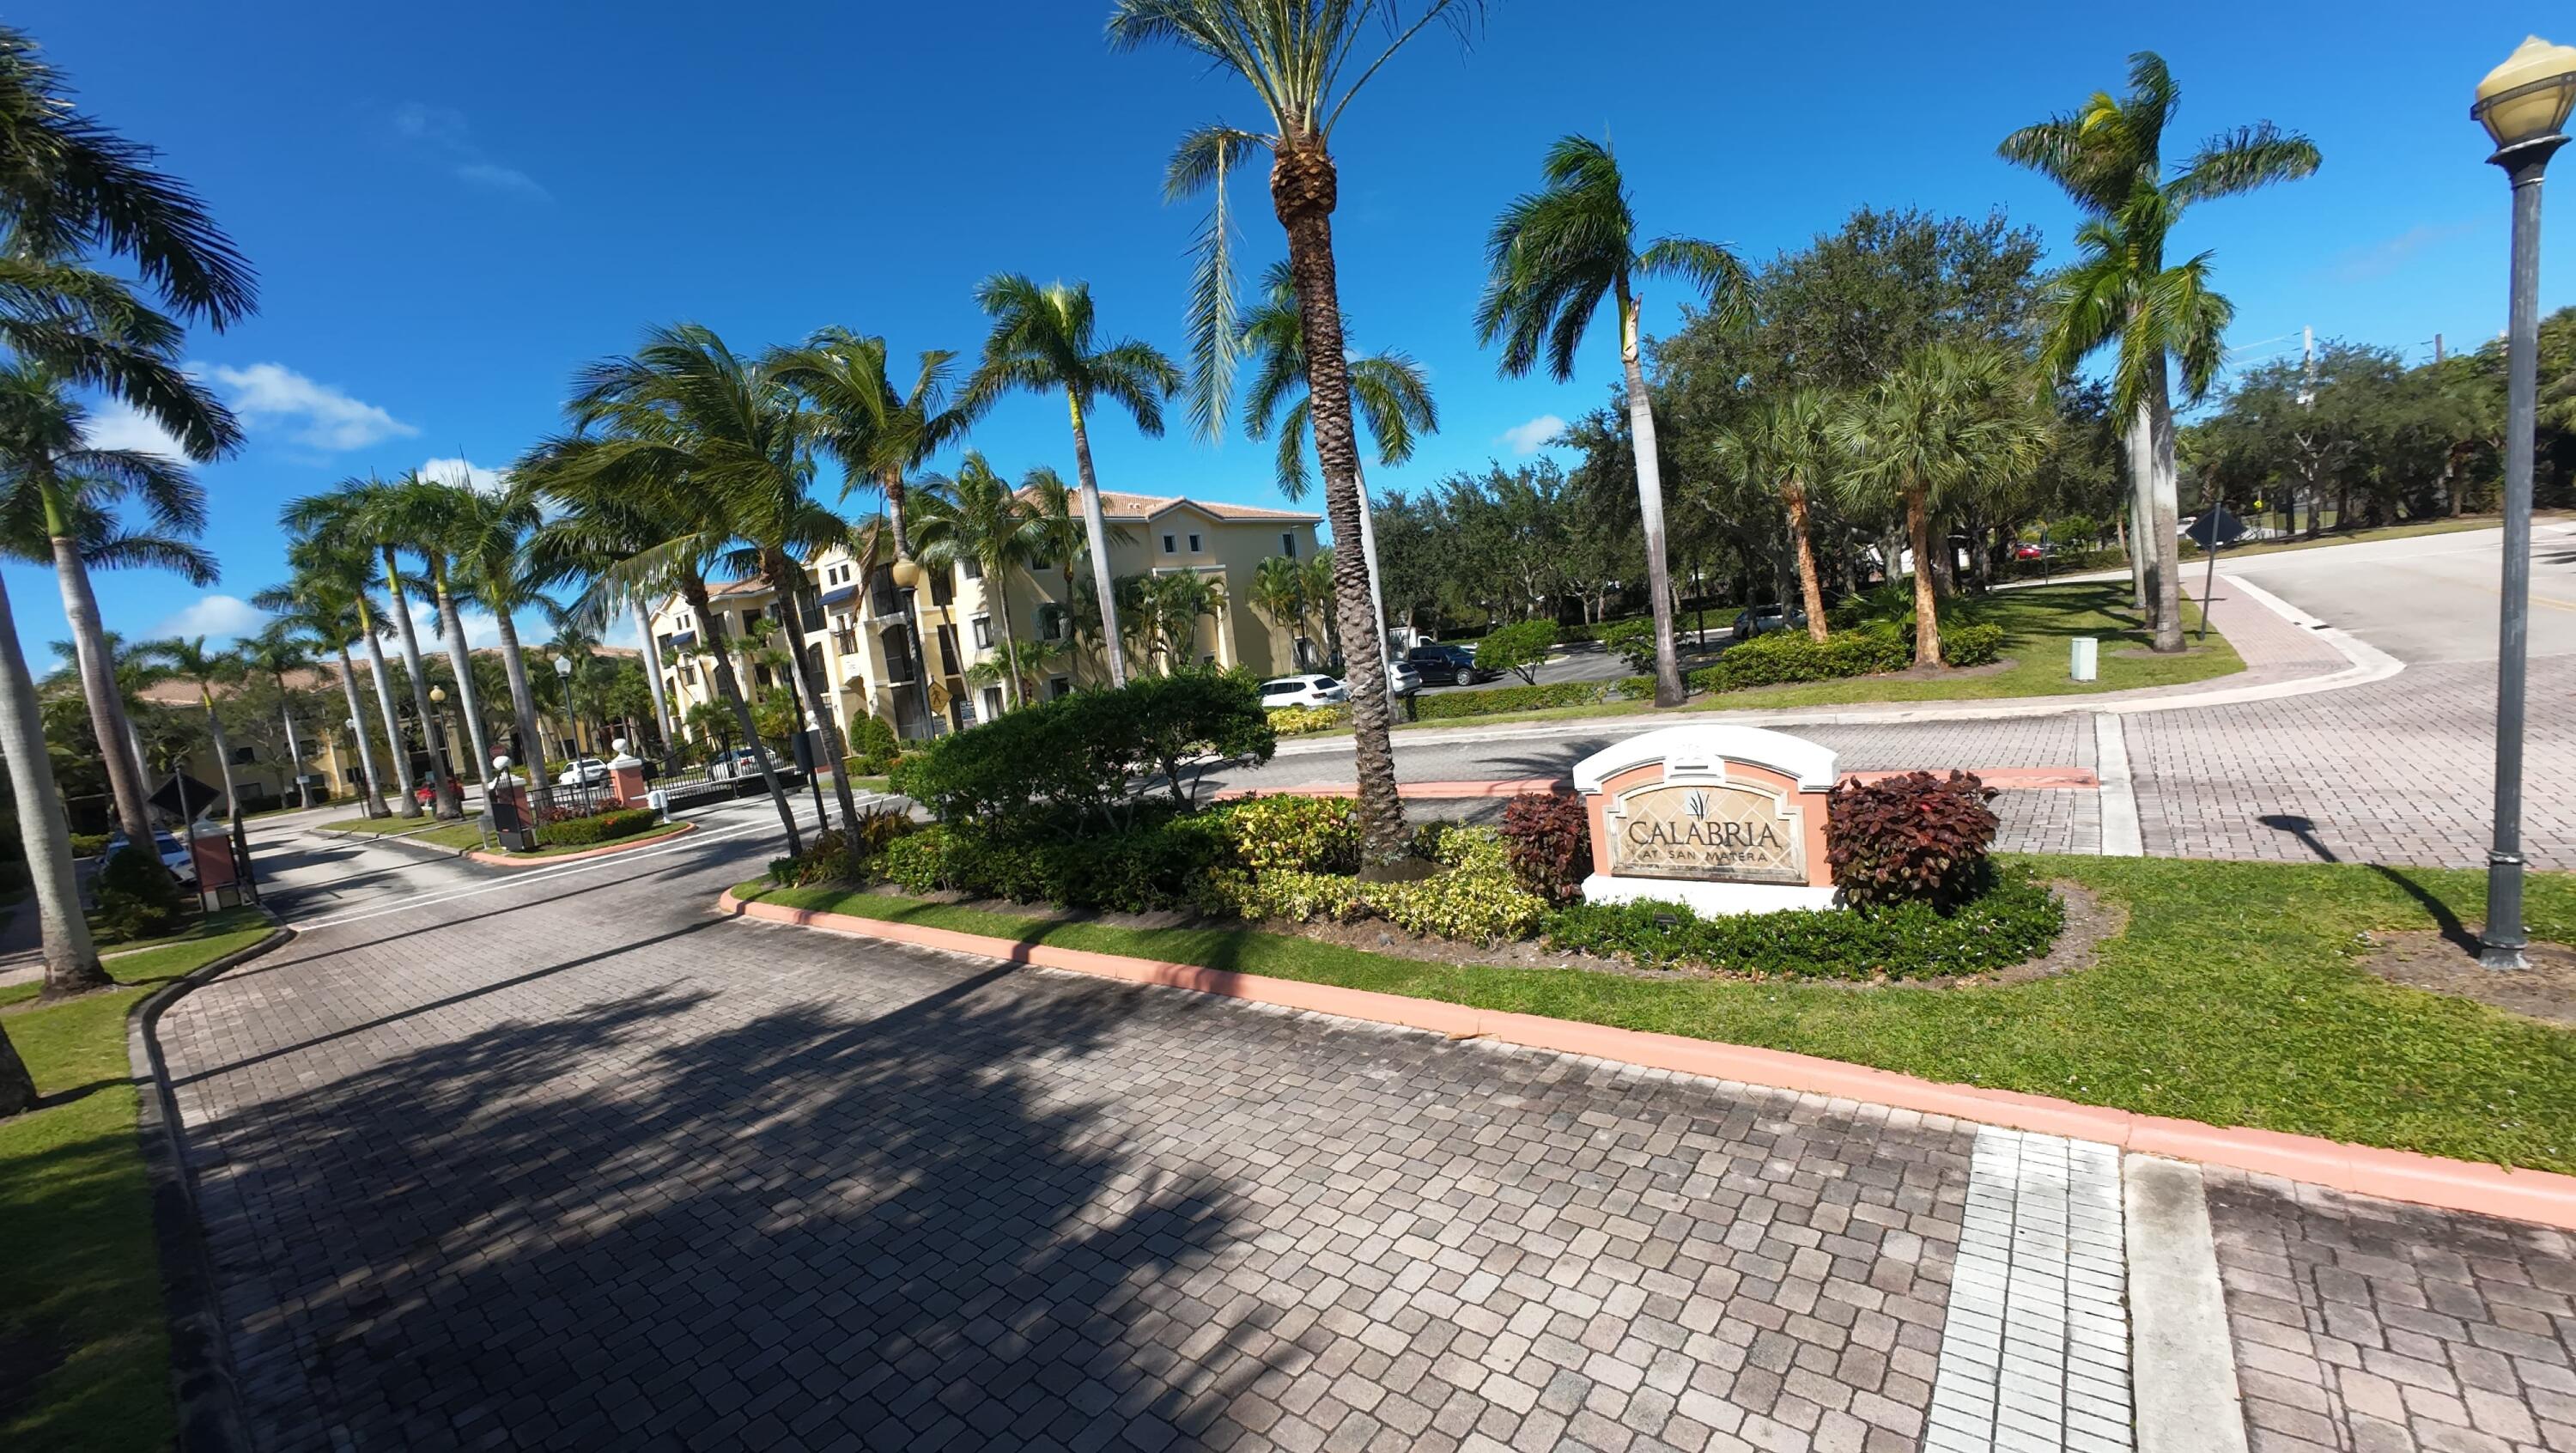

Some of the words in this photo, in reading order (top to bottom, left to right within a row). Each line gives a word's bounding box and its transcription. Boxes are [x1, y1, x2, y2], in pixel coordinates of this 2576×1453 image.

[1629, 821, 1783, 849] CALABRIA
[1643, 850, 1658, 859] AT
[1668, 850, 1696, 860] SAN
[1705, 852, 1768, 862] MATERA
